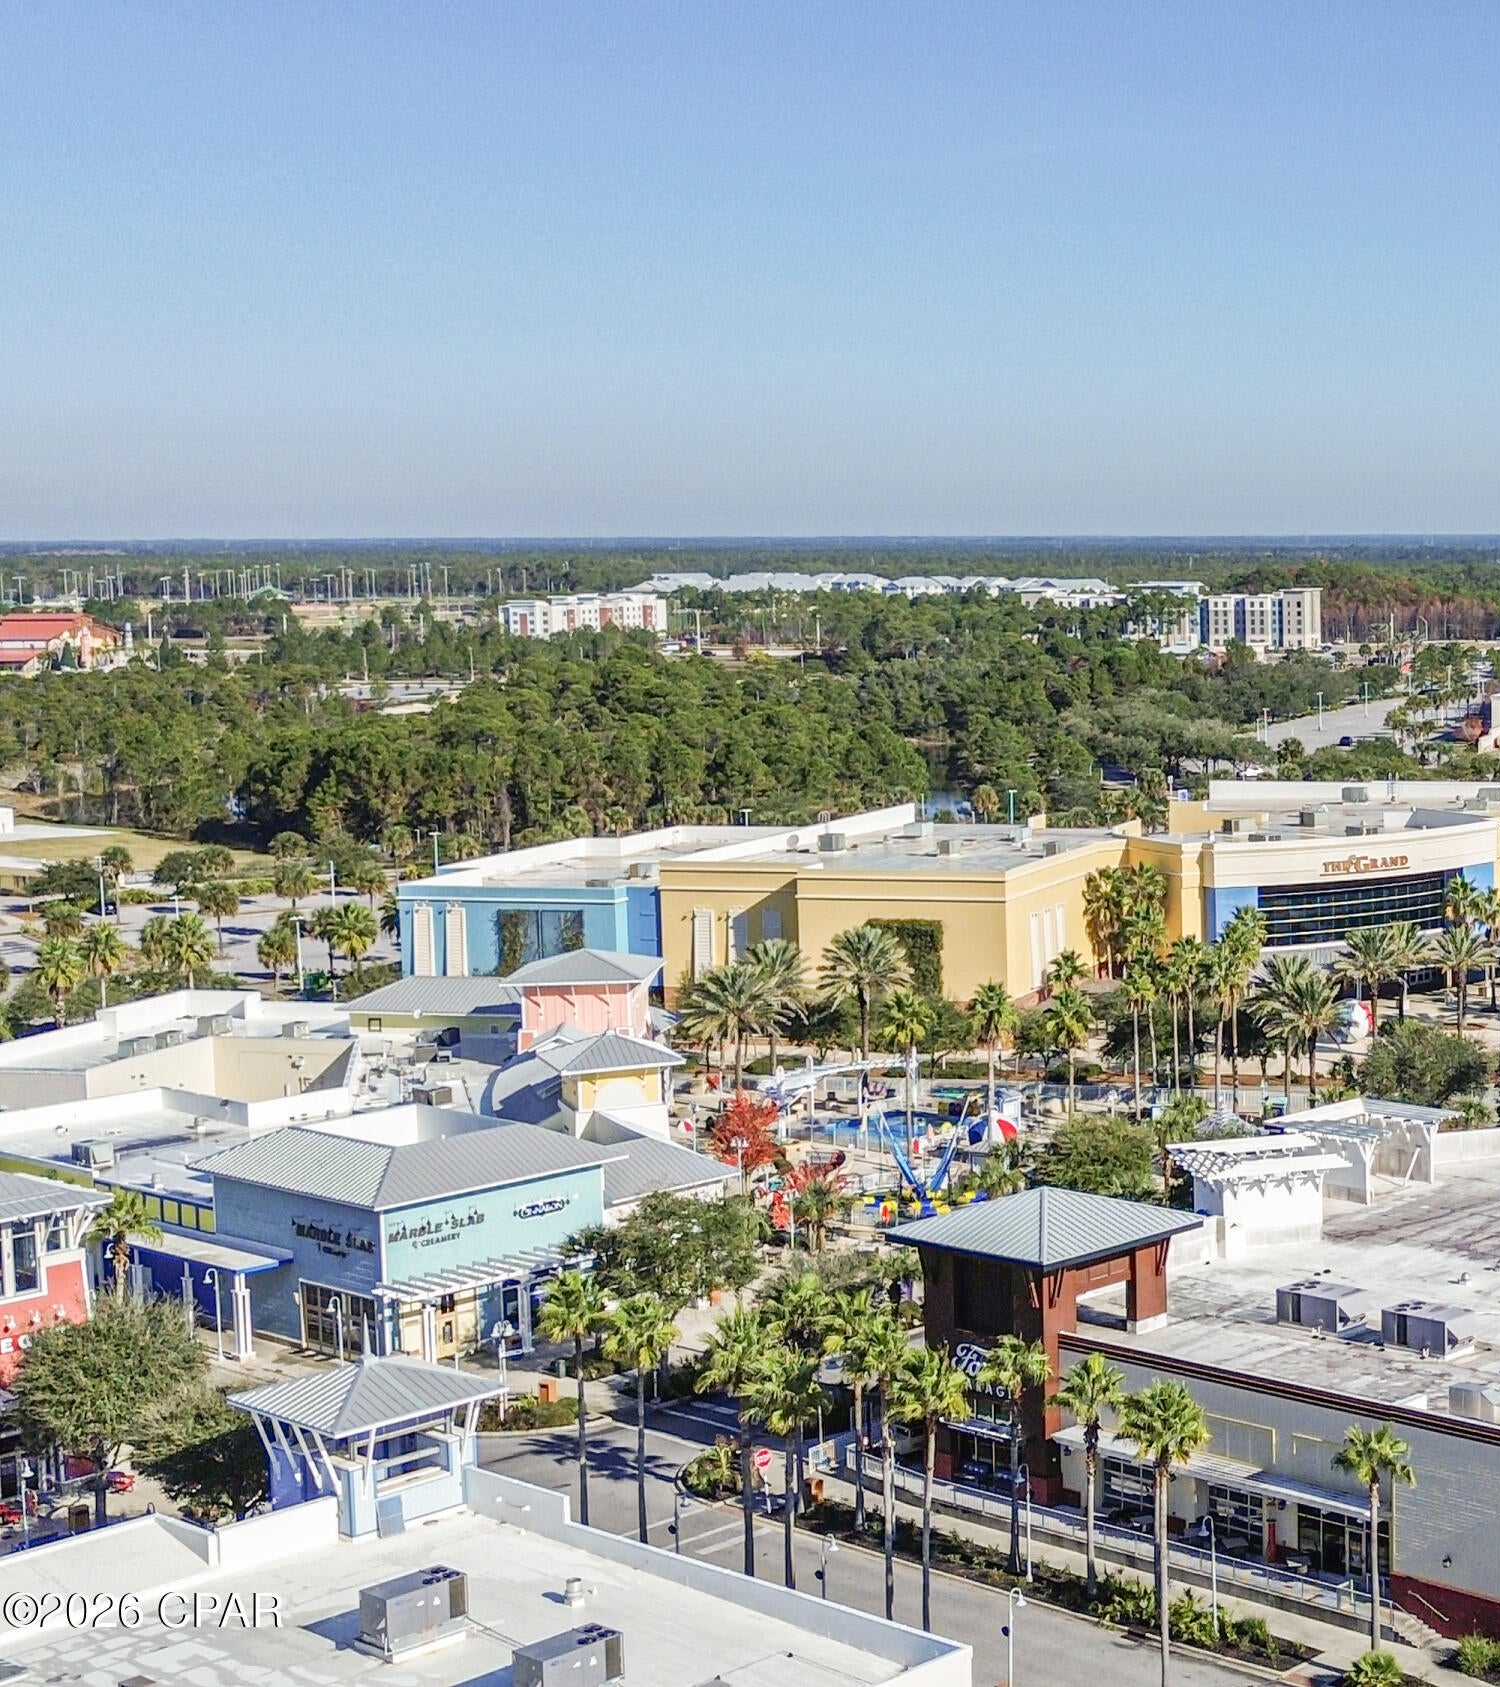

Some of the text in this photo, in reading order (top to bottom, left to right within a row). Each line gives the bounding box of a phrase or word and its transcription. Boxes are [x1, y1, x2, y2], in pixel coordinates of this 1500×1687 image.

[1355, 855, 1409, 873] GRAND
[386, 1212, 485, 1244] MARBLE SLAB
